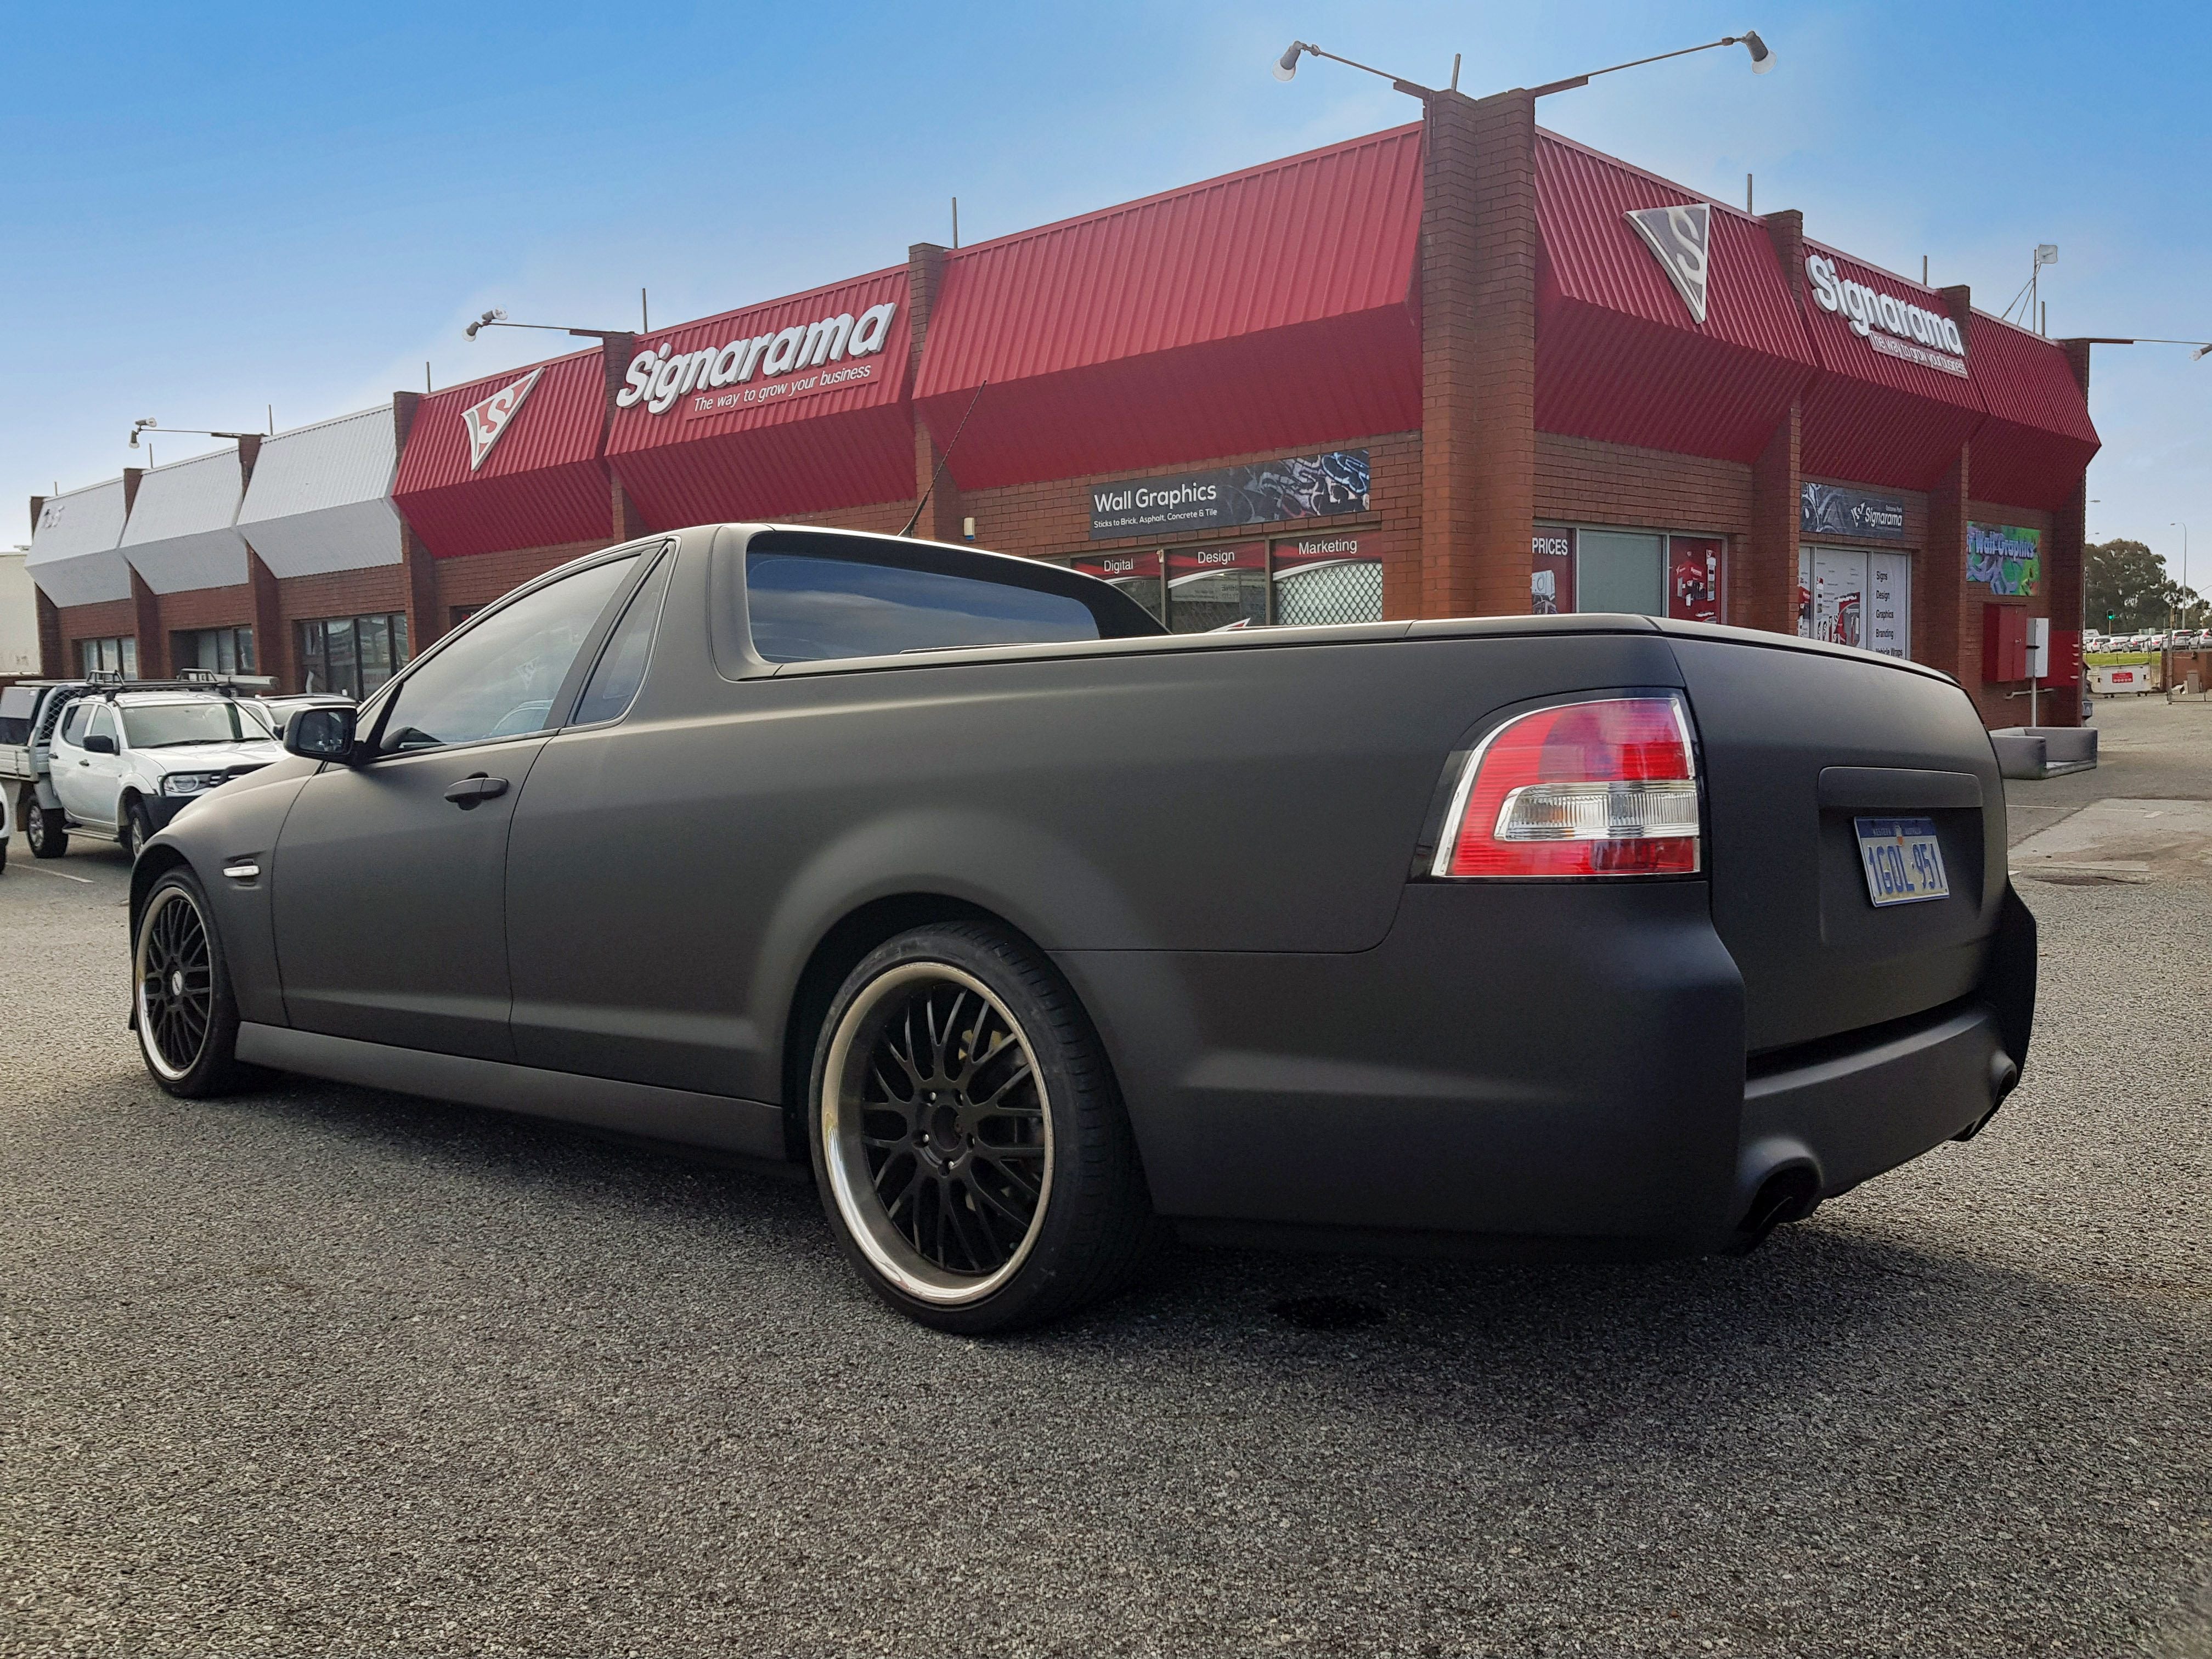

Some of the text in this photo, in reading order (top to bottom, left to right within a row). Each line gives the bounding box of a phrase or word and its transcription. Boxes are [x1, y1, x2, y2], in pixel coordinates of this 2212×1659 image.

[1805, 255, 1965, 357] Signarama
[1869, 331, 1886, 349] The
[1885, 338, 1903, 358] way
[1901, 343, 1911, 358] to
[616, 302, 897, 415] Signarama
[694, 364, 872, 411] The way to grow your business
[1094, 482, 1217, 512] Wall Graphics
[1093, 520, 1113, 528] Sticks
[1167, 510, 1198, 521] Concrete
[1205, 508, 1218, 517] Tile
[1865, 506, 1903, 527] Signarama
[1297, 538, 1358, 555] Marketing
[1532, 537, 1568, 556] PRICES
[1103, 557, 1133, 575] Digital
[1197, 549, 1235, 565] Design
[1876, 571, 1888, 582] Signs
[1876, 590, 1891, 602] Design
[1876, 609, 1894, 620] Graphics
[1876, 628, 1894, 640] Branding
